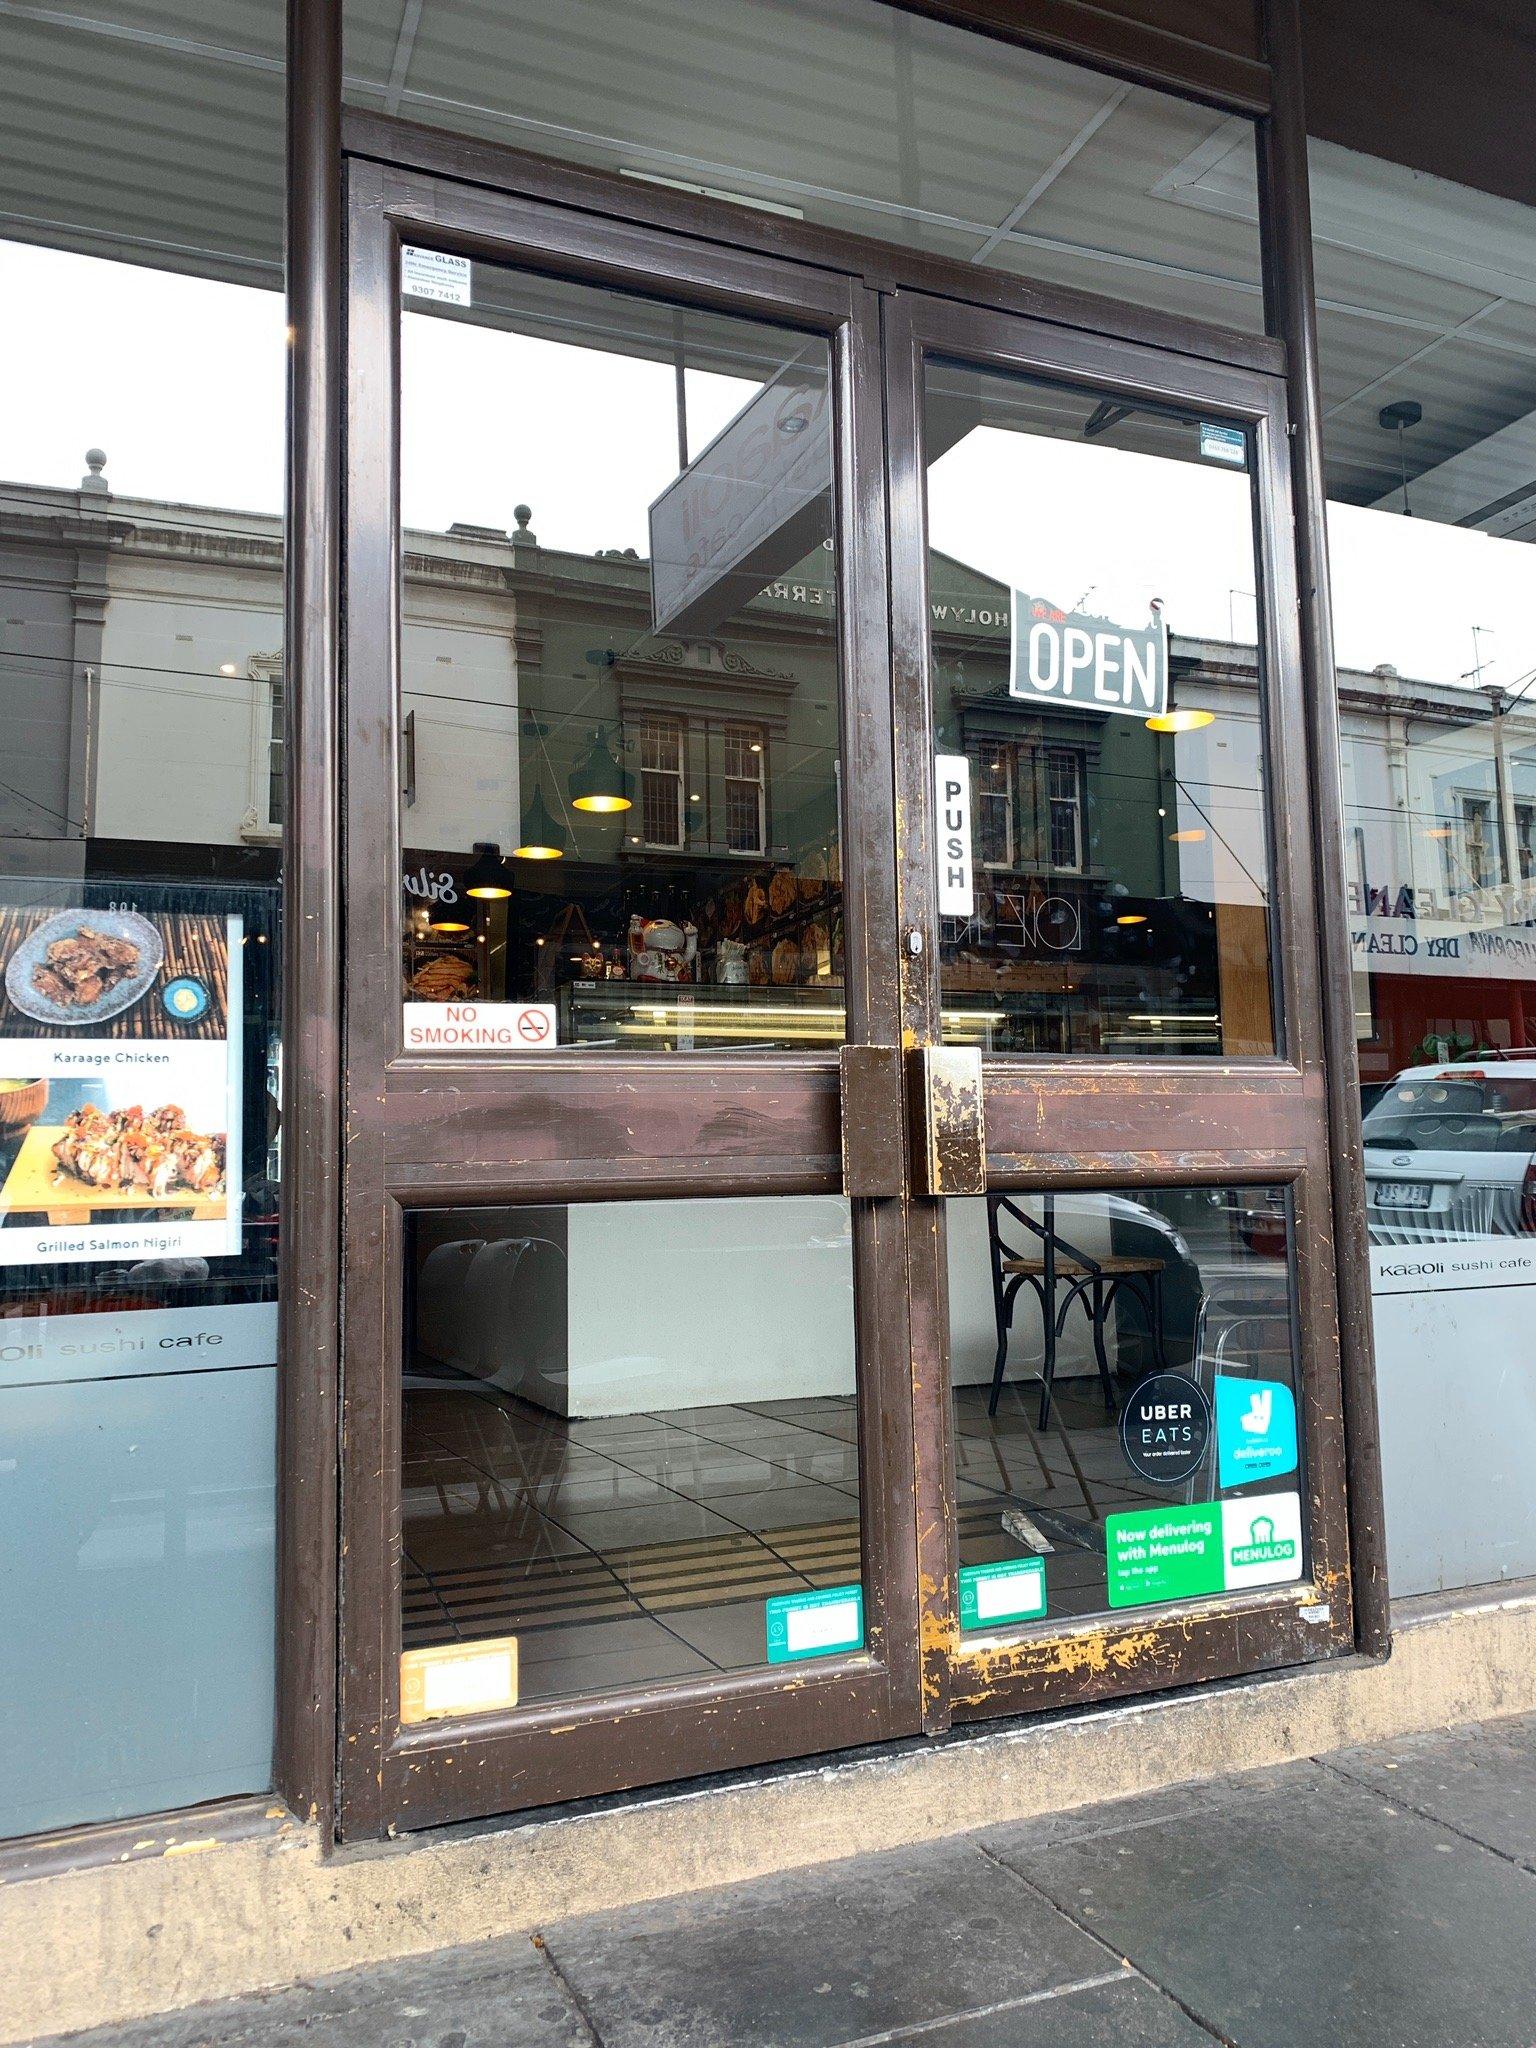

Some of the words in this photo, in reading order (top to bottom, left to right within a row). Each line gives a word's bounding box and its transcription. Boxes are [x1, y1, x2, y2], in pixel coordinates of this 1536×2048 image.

[435, 255, 467, 268] GLASS
[438, 290, 461, 302] 7412
[1028, 622, 1156, 708] OPEN
[945, 780, 964, 888] PUSH
[446, 1007, 477, 1022] NO
[410, 1028, 512, 1043] SMOKING
[54, 1053, 111, 1065] Karaage
[115, 1053, 170, 1063] Chicken
[37, 1241, 85, 1253] Grilled
[90, 1239, 139, 1251] Salmon
[144, 1236, 182, 1251] Nigiri
[1452, 1258, 1494, 1272] sushi
[1499, 1257, 1532, 1269] cafe
[59, 1337, 145, 1356] sushi
[159, 1332, 224, 1349] cafe
[1140, 1403, 1192, 1421] UBER
[1141, 1426, 1192, 1443] EATS
[1233, 1446, 1283, 1460] deliveroo
[1116, 1529, 1146, 1544] Now
[1149, 1520, 1212, 1539] delivering
[1117, 1547, 1147, 1563] with
[1149, 1540, 1205, 1559] Menulog
[1233, 1543, 1292, 1563] MENULOG
